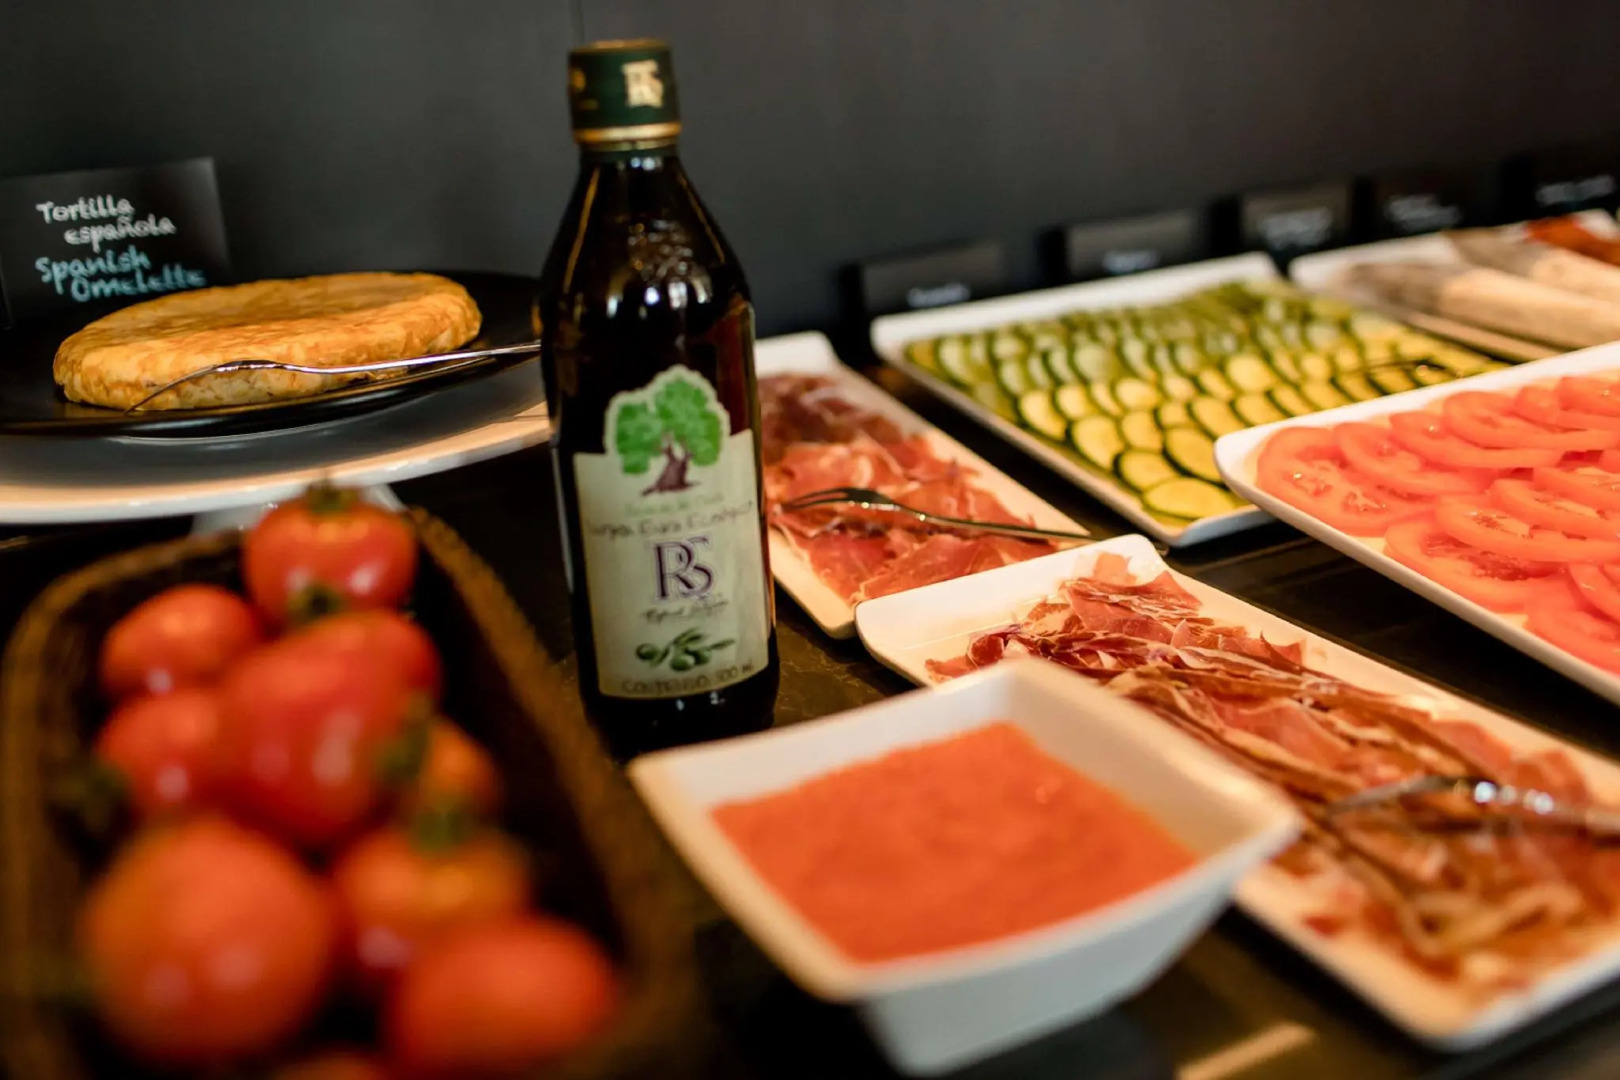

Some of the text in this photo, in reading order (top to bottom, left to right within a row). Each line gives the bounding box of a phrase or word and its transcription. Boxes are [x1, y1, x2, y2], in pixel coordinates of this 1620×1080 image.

[36, 195, 134, 223] Tortilla
[64, 213, 176, 253] española
[35, 245, 150, 294] Spanish
[71, 264, 205, 301] Omelette
[654, 534, 716, 602] RS
